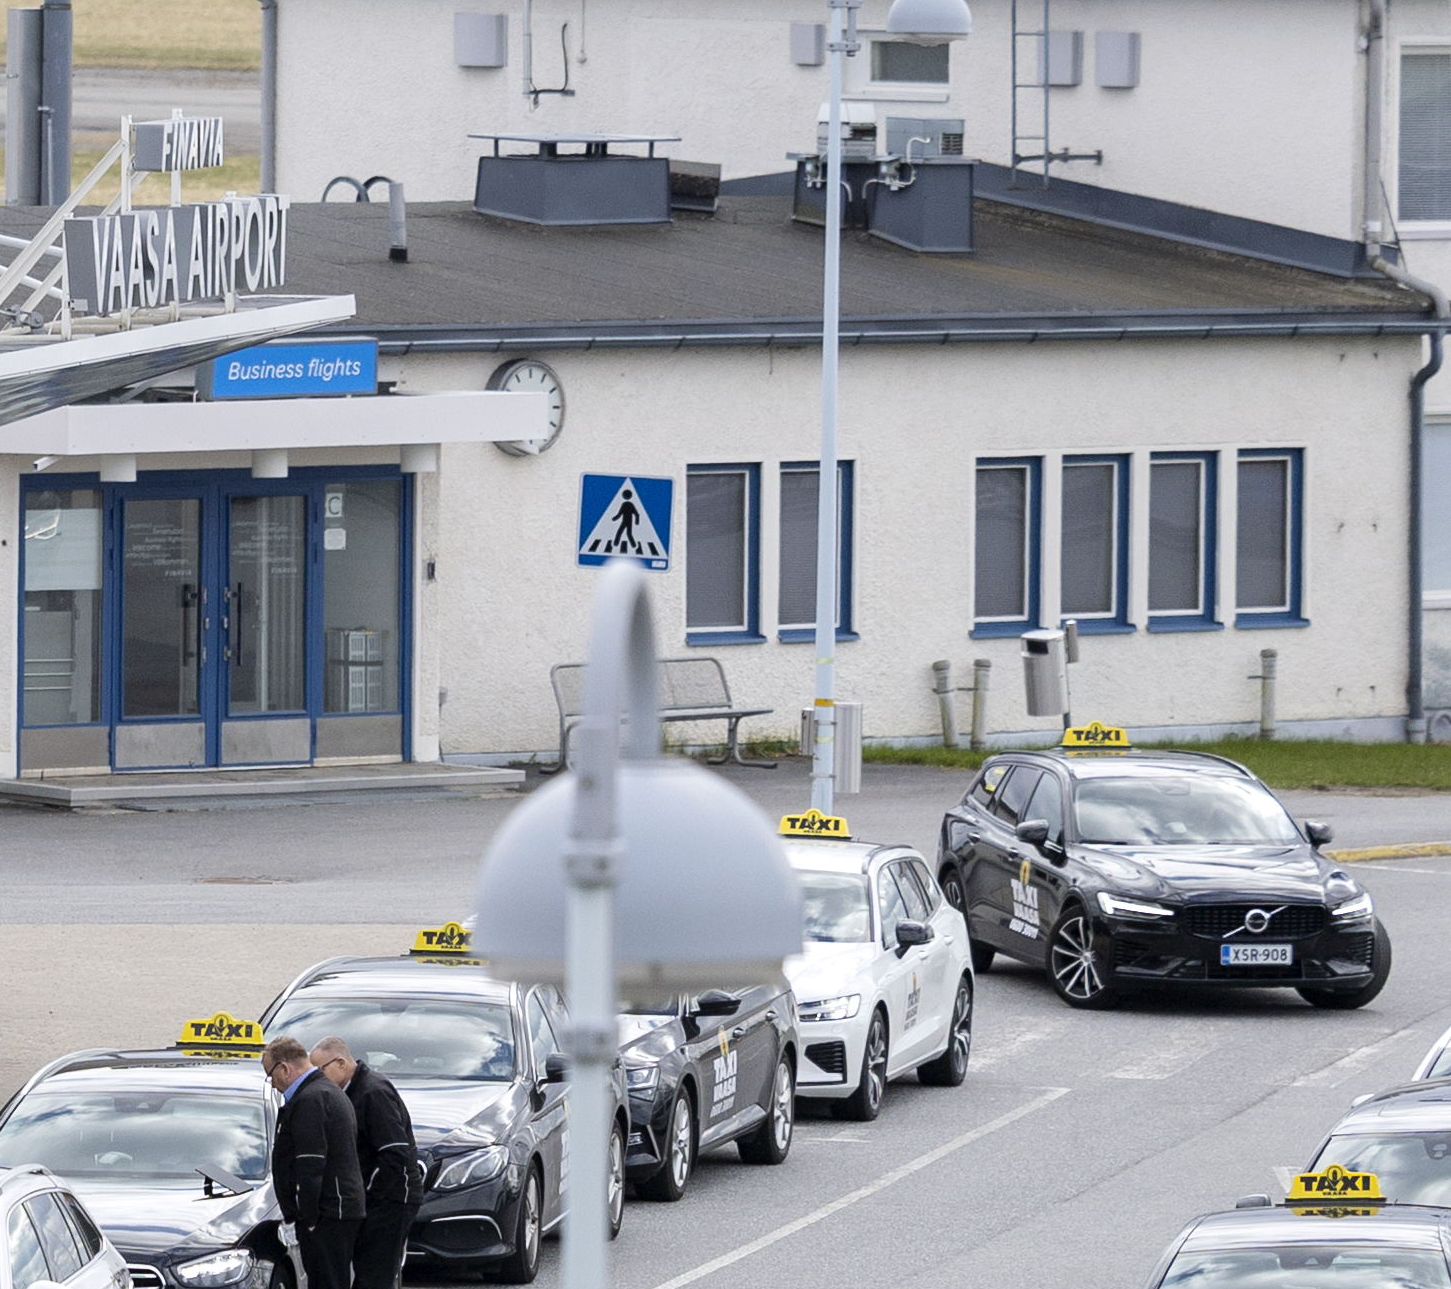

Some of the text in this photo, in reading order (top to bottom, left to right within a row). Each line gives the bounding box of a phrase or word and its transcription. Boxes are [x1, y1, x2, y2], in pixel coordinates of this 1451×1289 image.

[162, 116, 223, 172] FINAVIA
[92, 194, 290, 313] VAASA AIRPORT
[227, 355, 361, 382] Business flights
[1073, 730, 1120, 741] TAXI
[787, 817, 840, 831] TAXI
[423, 931, 473, 947] TAX
[1232, 948, 1288, 962] XSR-908
[191, 1022, 253, 1038] TAXI
[1300, 1175, 1371, 1191] TAXI
